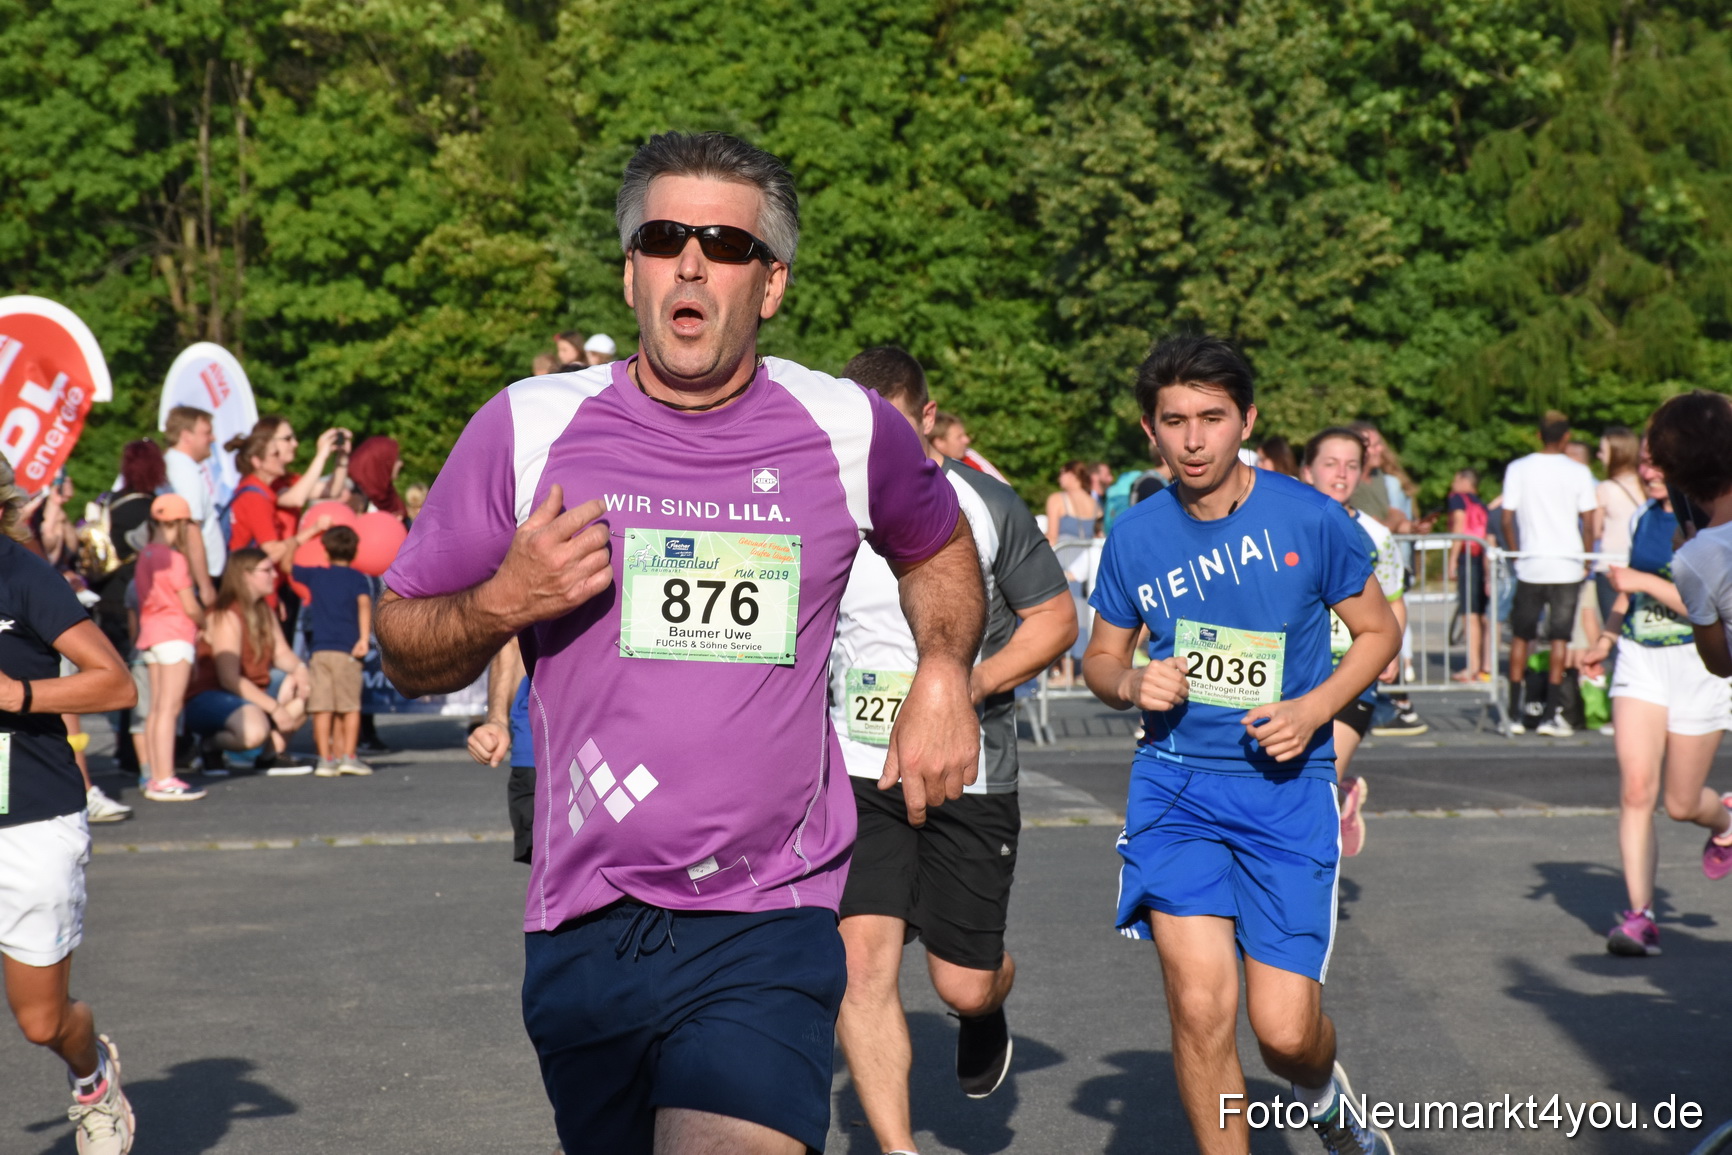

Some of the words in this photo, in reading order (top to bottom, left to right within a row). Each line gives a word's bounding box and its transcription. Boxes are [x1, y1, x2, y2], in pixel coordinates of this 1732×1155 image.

[603, 494, 651, 514] WIR
[661, 499, 720, 519] SIND
[729, 503, 791, 522] LILA.
[652, 555, 720, 570] firmenlauf
[759, 569, 789, 580] 2019
[661, 578, 759, 626] 876
[669, 626, 721, 640] Baumer
[724, 628, 752, 640] Uwe
[656, 639, 688, 649] FUCHS
[690, 640, 698, 649] &
[700, 640, 728, 650] Söhne
[730, 641, 763, 651] Service
[1191, 637, 1233, 651] firmenlauf
[1186, 651, 1267, 688] 2036
[1190, 679, 1237, 695] Brachvogel
[1204, 690, 1241, 701] Technologies
